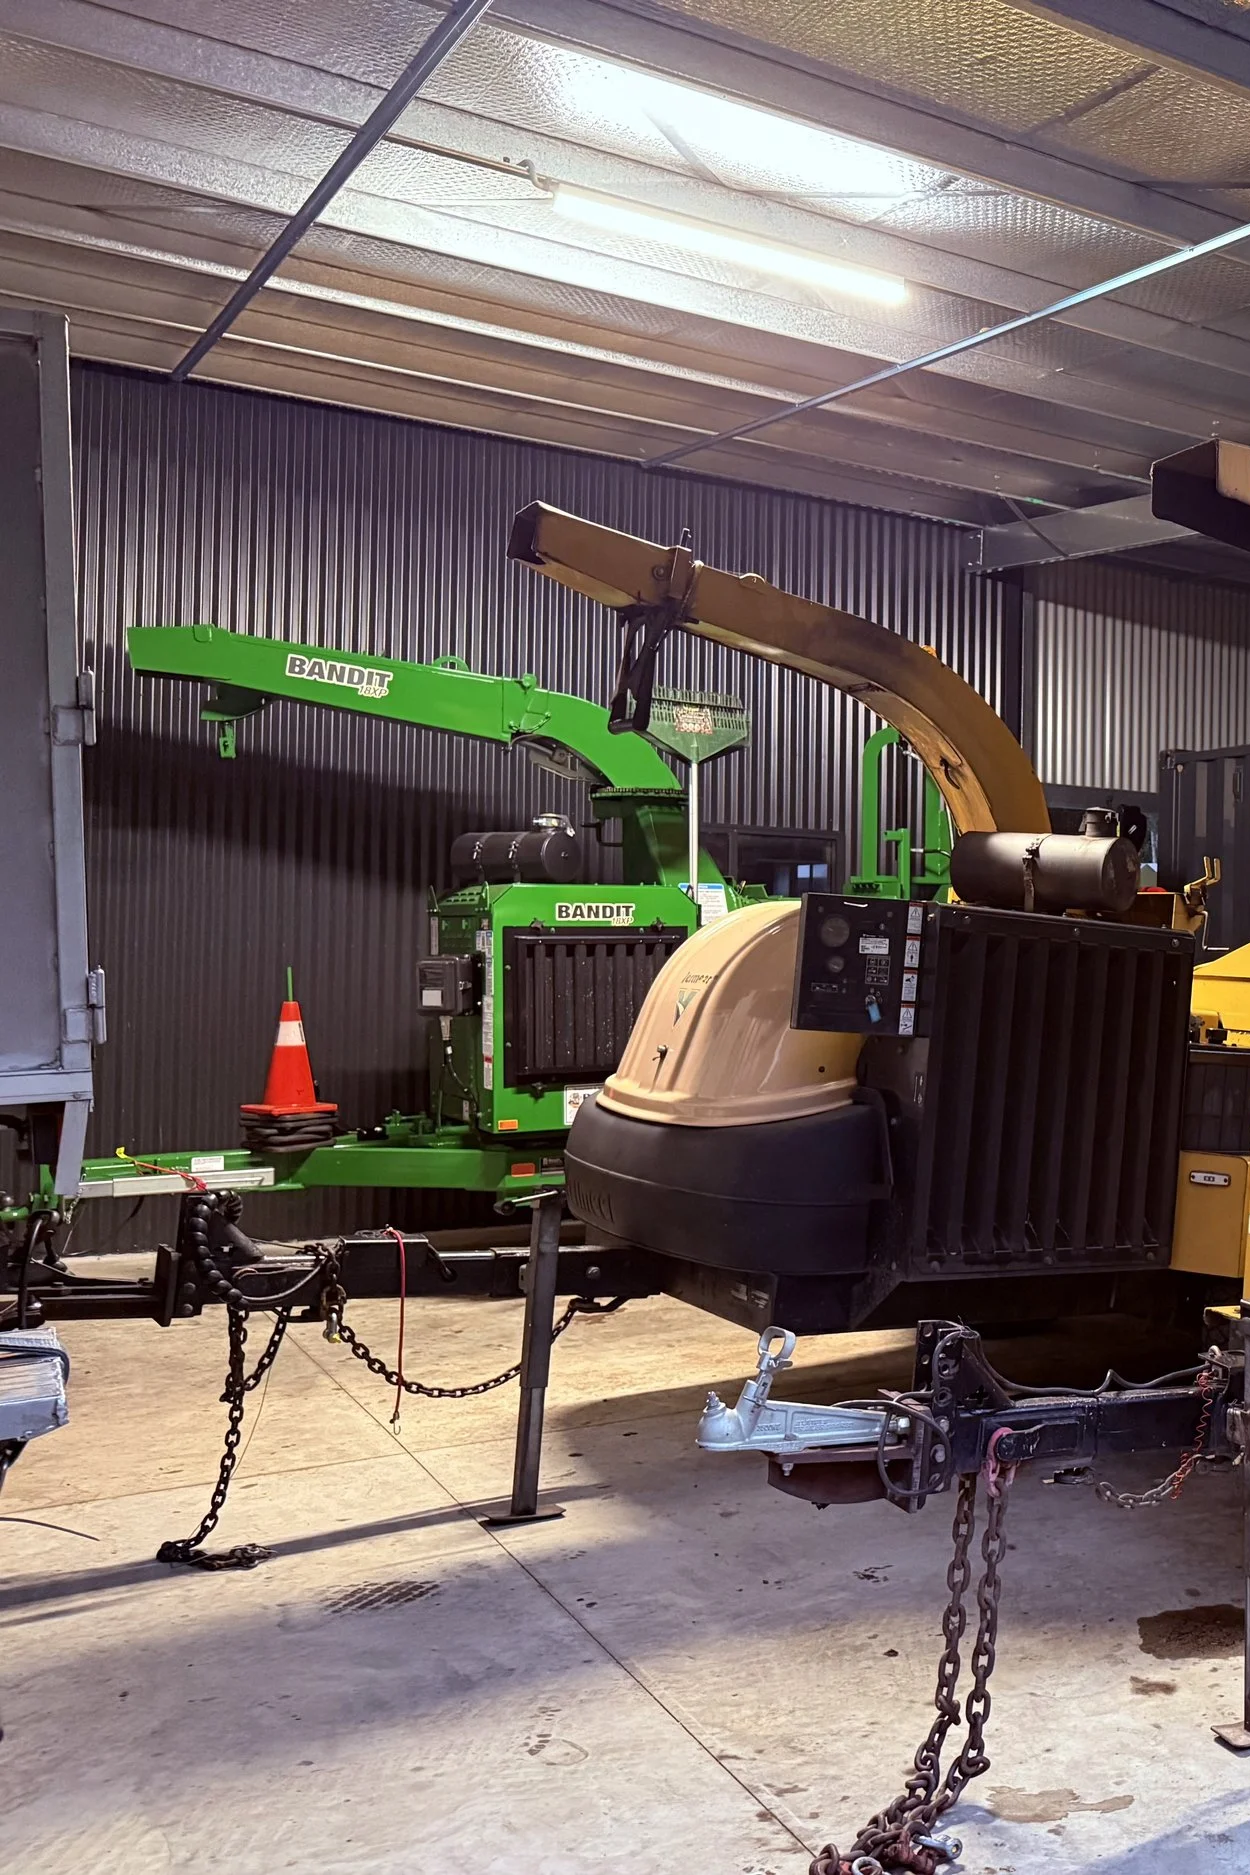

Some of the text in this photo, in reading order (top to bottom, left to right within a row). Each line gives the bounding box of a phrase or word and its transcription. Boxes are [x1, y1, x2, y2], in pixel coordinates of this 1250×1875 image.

[287, 656, 391, 688] BANDIT
[359, 685, 388, 698] 18XP
[557, 904, 633, 919] BANDIT
